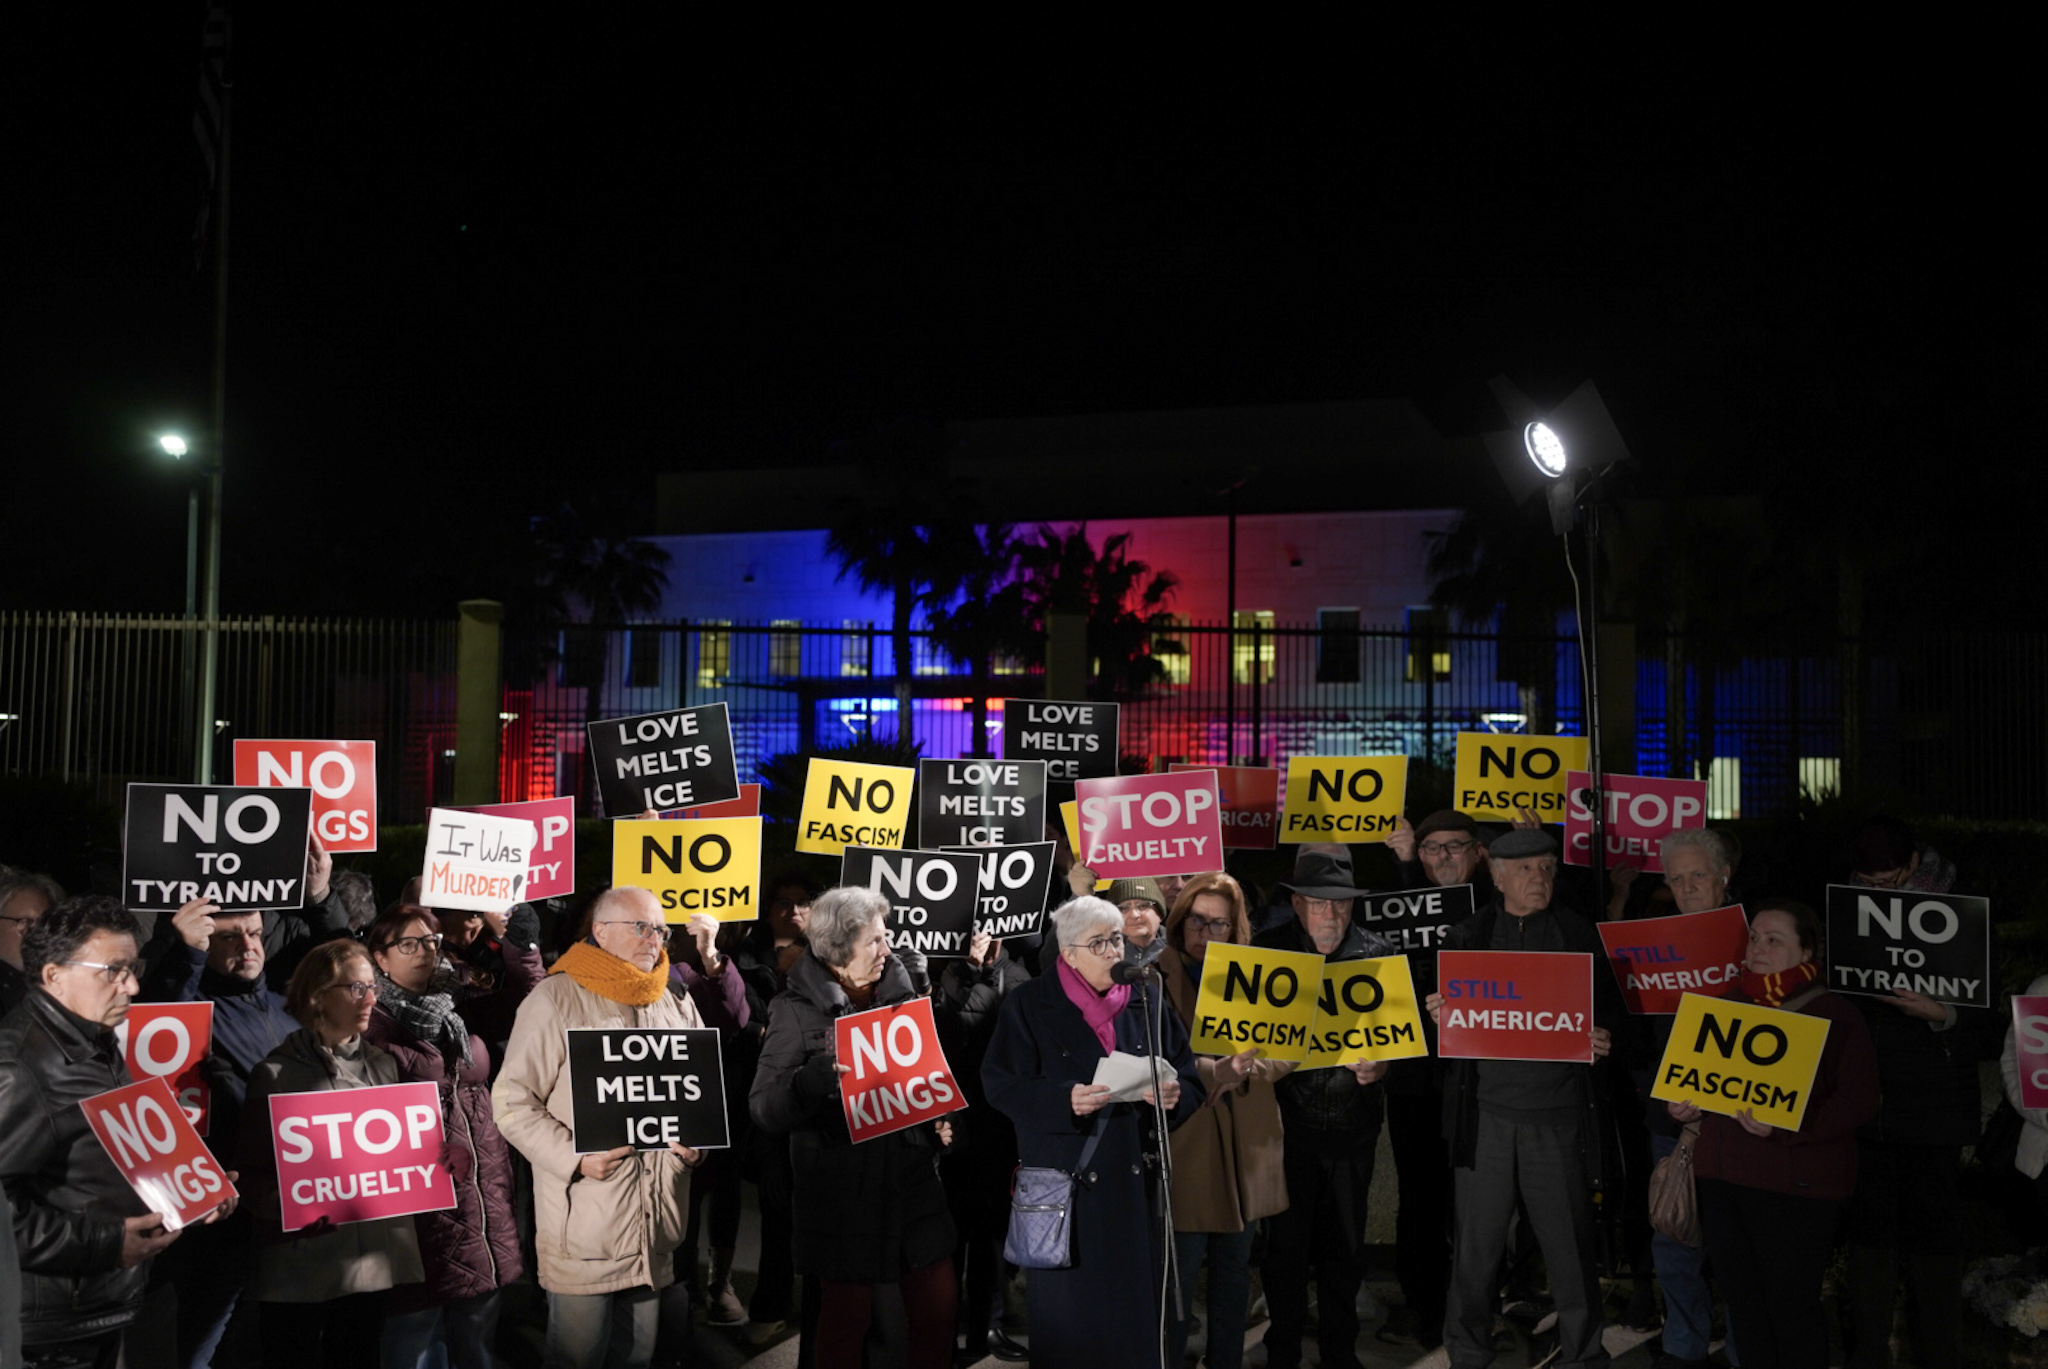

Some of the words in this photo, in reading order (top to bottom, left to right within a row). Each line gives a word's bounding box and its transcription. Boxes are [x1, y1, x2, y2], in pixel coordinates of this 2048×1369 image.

[1028, 704, 1093, 725] LOVE
[619, 712, 699, 746] LOVE
[1021, 732, 1099, 753] MELTS
[258, 751, 355, 799] NO
[616, 744, 711, 779] MELTS
[948, 764, 1019, 786] LOVE
[1047, 759, 1079, 778] CE
[1480, 746, 1560, 779] NO
[644, 780, 694, 809] ICE
[827, 774, 894, 814] NO
[1308, 768, 1383, 803] NO
[163, 793, 280, 844] NO
[940, 795, 1025, 817] MELTS
[1081, 789, 1213, 833] STOP
[1220, 811, 1271, 829] RICA?
[806, 821, 900, 846] FASCISM
[961, 825, 1004, 846] ICE
[1289, 814, 1396, 832] FASCISM
[195, 852, 241, 875] TO
[642, 834, 731, 874] NO
[1089, 836, 1208, 864] CRUELTY
[132, 879, 297, 903] TYRANNY
[869, 855, 958, 900] NO
[661, 886, 749, 909] SCISM
[981, 896, 1008, 914] TO
[1364, 893, 1443, 922] LOVE
[893, 905, 927, 926] TO
[974, 911, 1039, 935] RANNY
[1857, 894, 1959, 944] NO
[885, 929, 967, 952] RANNY
[1382, 924, 1452, 951] ELTS
[1615, 944, 1684, 964] STILL
[1885, 946, 1925, 969] TO
[1224, 961, 1298, 1008] NO
[1447, 980, 1523, 1000] STILL
[1627, 963, 1740, 990] AMERICA
[1834, 965, 1981, 999] TYRANNY
[1200, 1016, 1306, 1047] FASCISM
[1447, 1009, 1584, 1032] AMERICA?
[602, 1034, 689, 1061] LOVE
[851, 1014, 922, 1080] NO
[1309, 1023, 1414, 1054] ASCISM
[1694, 1013, 1788, 1066] NO
[596, 1075, 701, 1103] MELTS
[849, 1071, 954, 1130] KINGS
[1665, 1063, 1798, 1112] FASCISM
[99, 1095, 177, 1169] NO
[278, 1105, 437, 1163] STOP
[626, 1116, 680, 1144] ICE
[291, 1164, 436, 1205] CRUELTY
